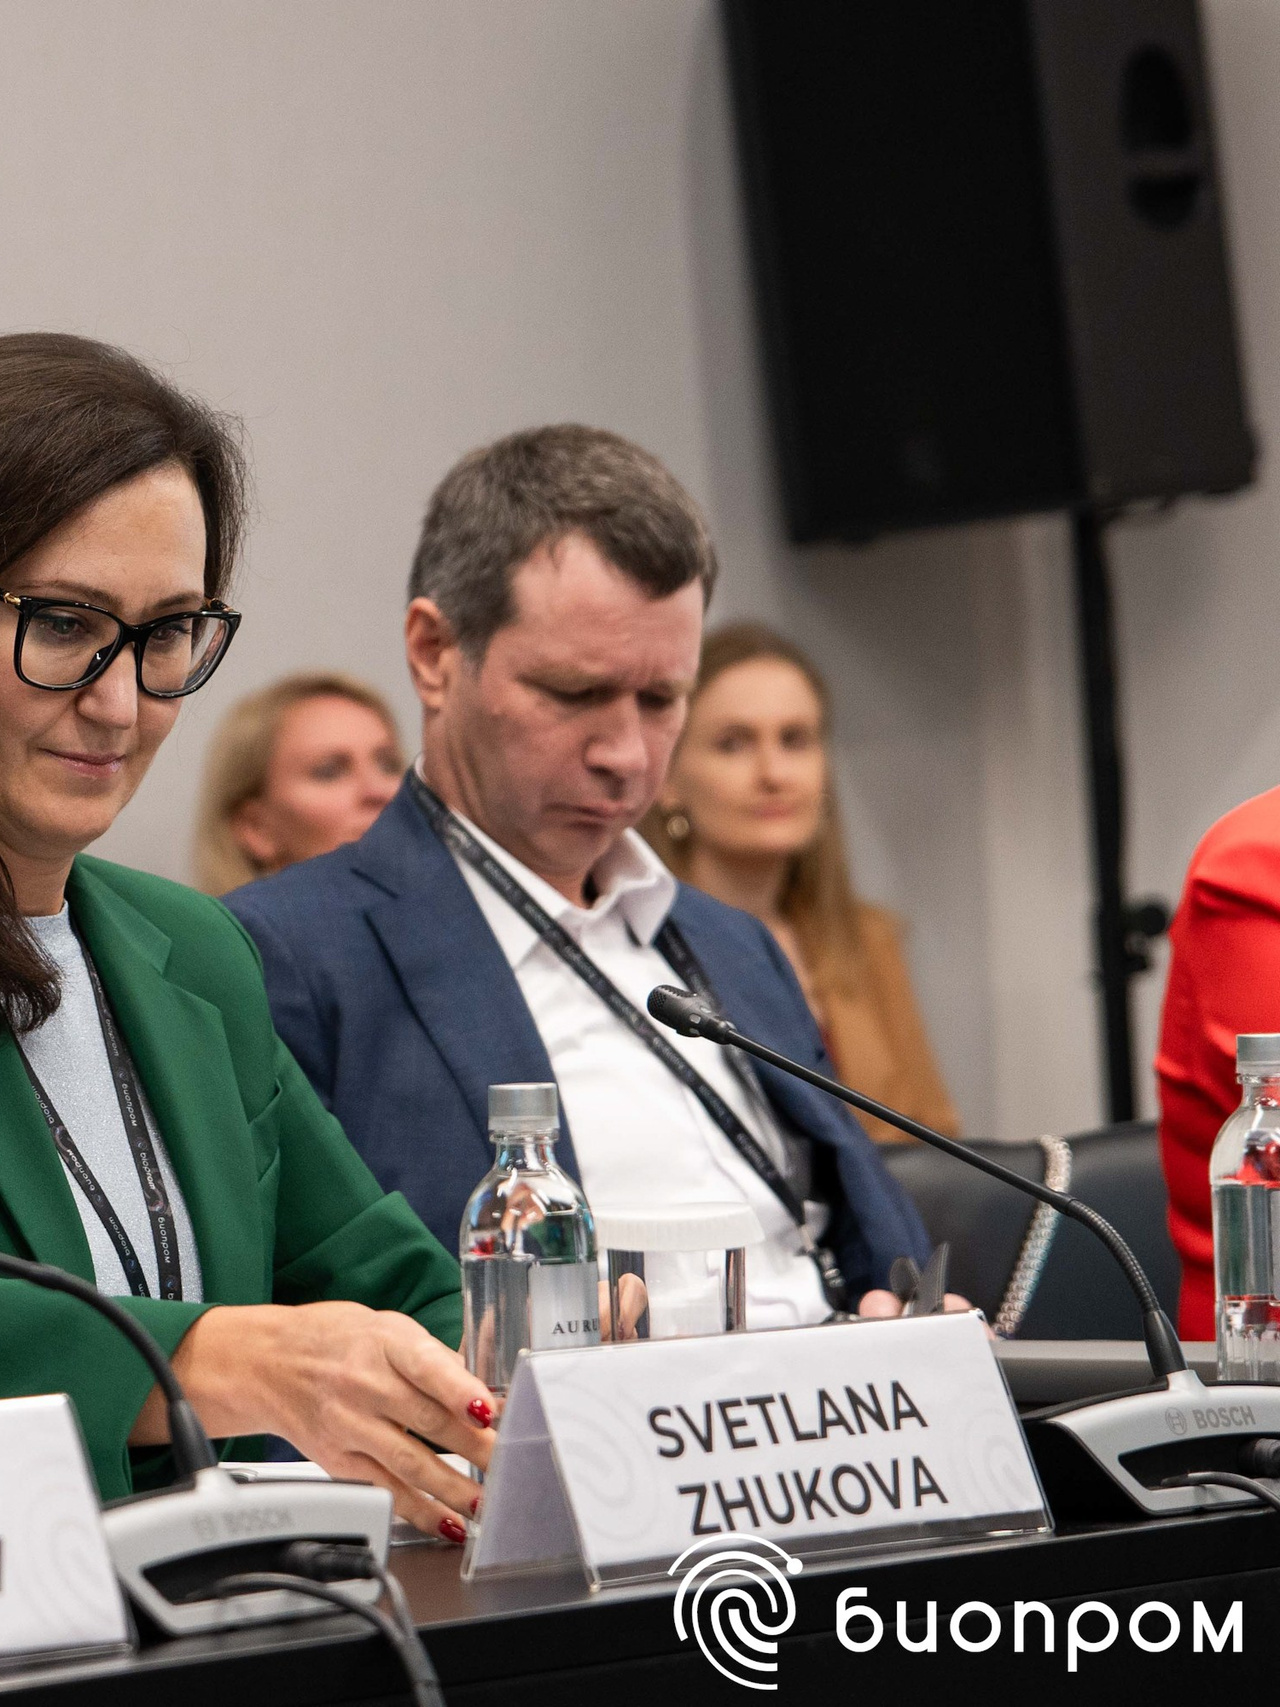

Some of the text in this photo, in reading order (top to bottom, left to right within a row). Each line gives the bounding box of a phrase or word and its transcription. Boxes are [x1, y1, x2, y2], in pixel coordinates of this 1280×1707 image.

[552, 1317, 599, 1335] AURU
[648, 1379, 929, 1459] SVETLANA
[1192, 1405, 1256, 1429] BOSCH
[677, 1455, 949, 1536] ZHUKOVA
